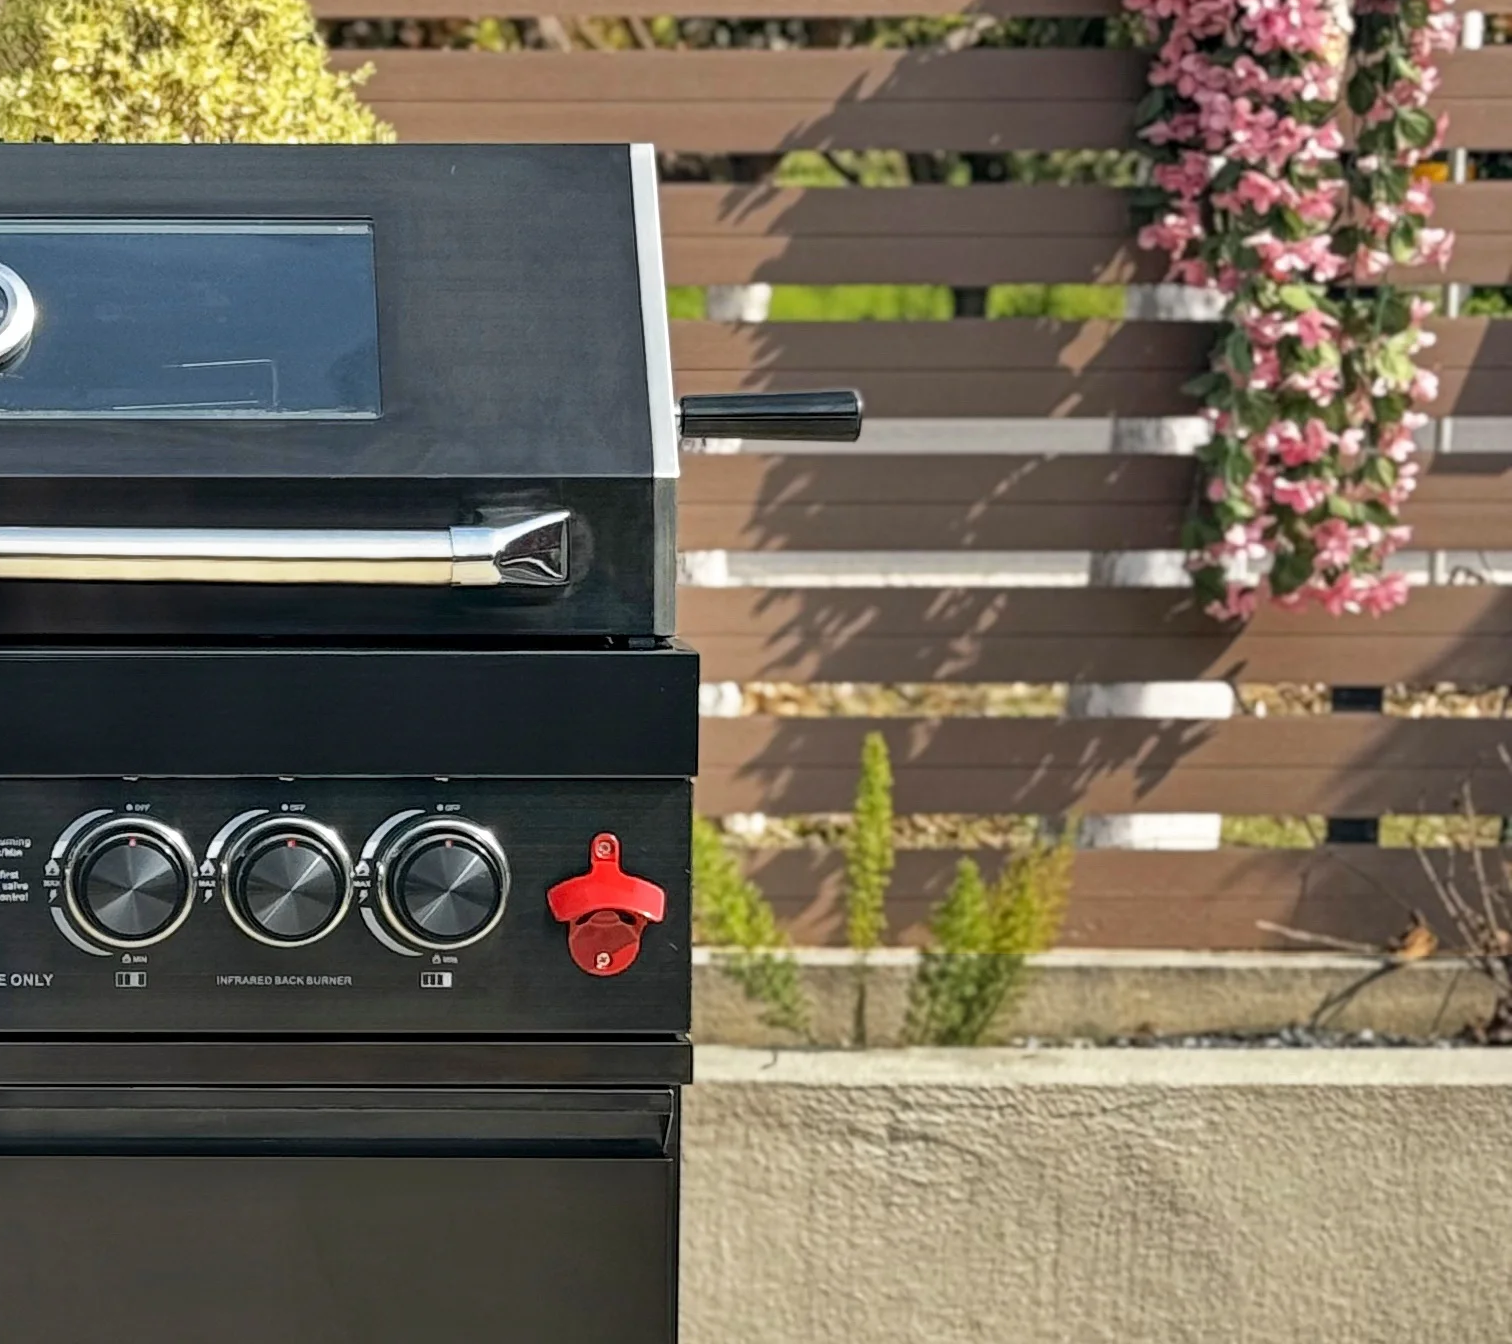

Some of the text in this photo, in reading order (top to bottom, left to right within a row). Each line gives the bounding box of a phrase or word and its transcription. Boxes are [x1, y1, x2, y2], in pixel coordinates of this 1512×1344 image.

[10, 973, 54, 987] ONLY
[216, 976, 352, 985] INFRARED BACK BURNER
